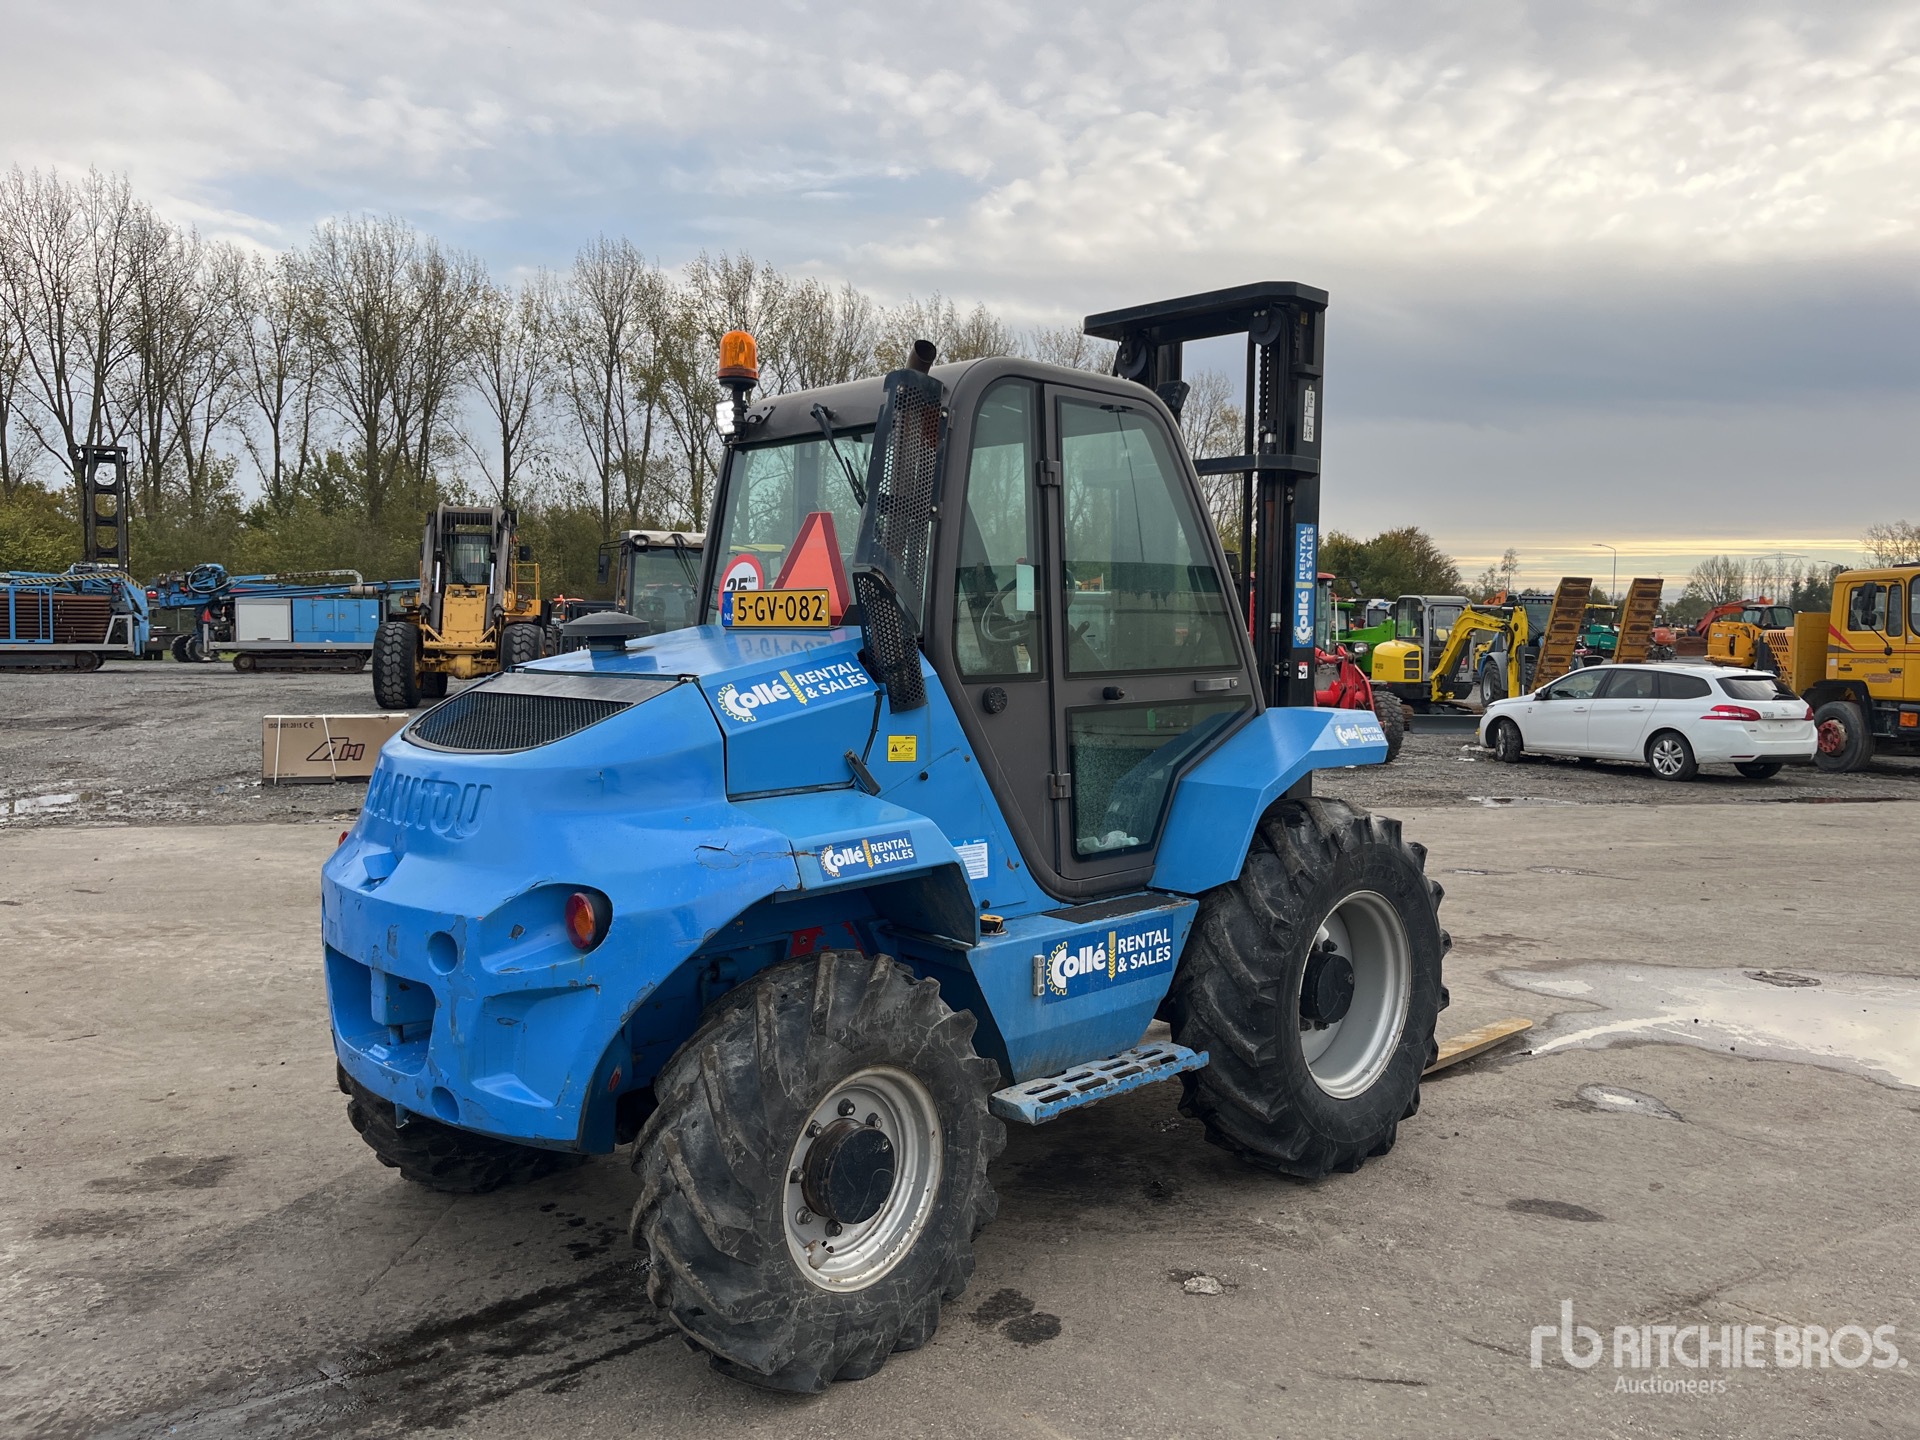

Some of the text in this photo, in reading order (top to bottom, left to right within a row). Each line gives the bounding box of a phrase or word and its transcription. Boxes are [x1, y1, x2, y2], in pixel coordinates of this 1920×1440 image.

[1298, 526, 1307, 580] RENTAL
[1306, 526, 1314, 580] & SALES
[724, 612, 732, 621] NL
[737, 595, 823, 622] 5-GV-082
[1296, 590, 1311, 640] Collé
[794, 661, 860, 686] RENTAL
[805, 673, 869, 699] & SALES
[723, 678, 792, 718] Collé
[824, 846, 865, 873] Collé
[870, 838, 911, 854] RENTAL
[874, 848, 914, 864] & SALES
[1118, 928, 1171, 954] RENTAL
[1051, 942, 1106, 989] Collé
[1117, 946, 1171, 973] & SALES
